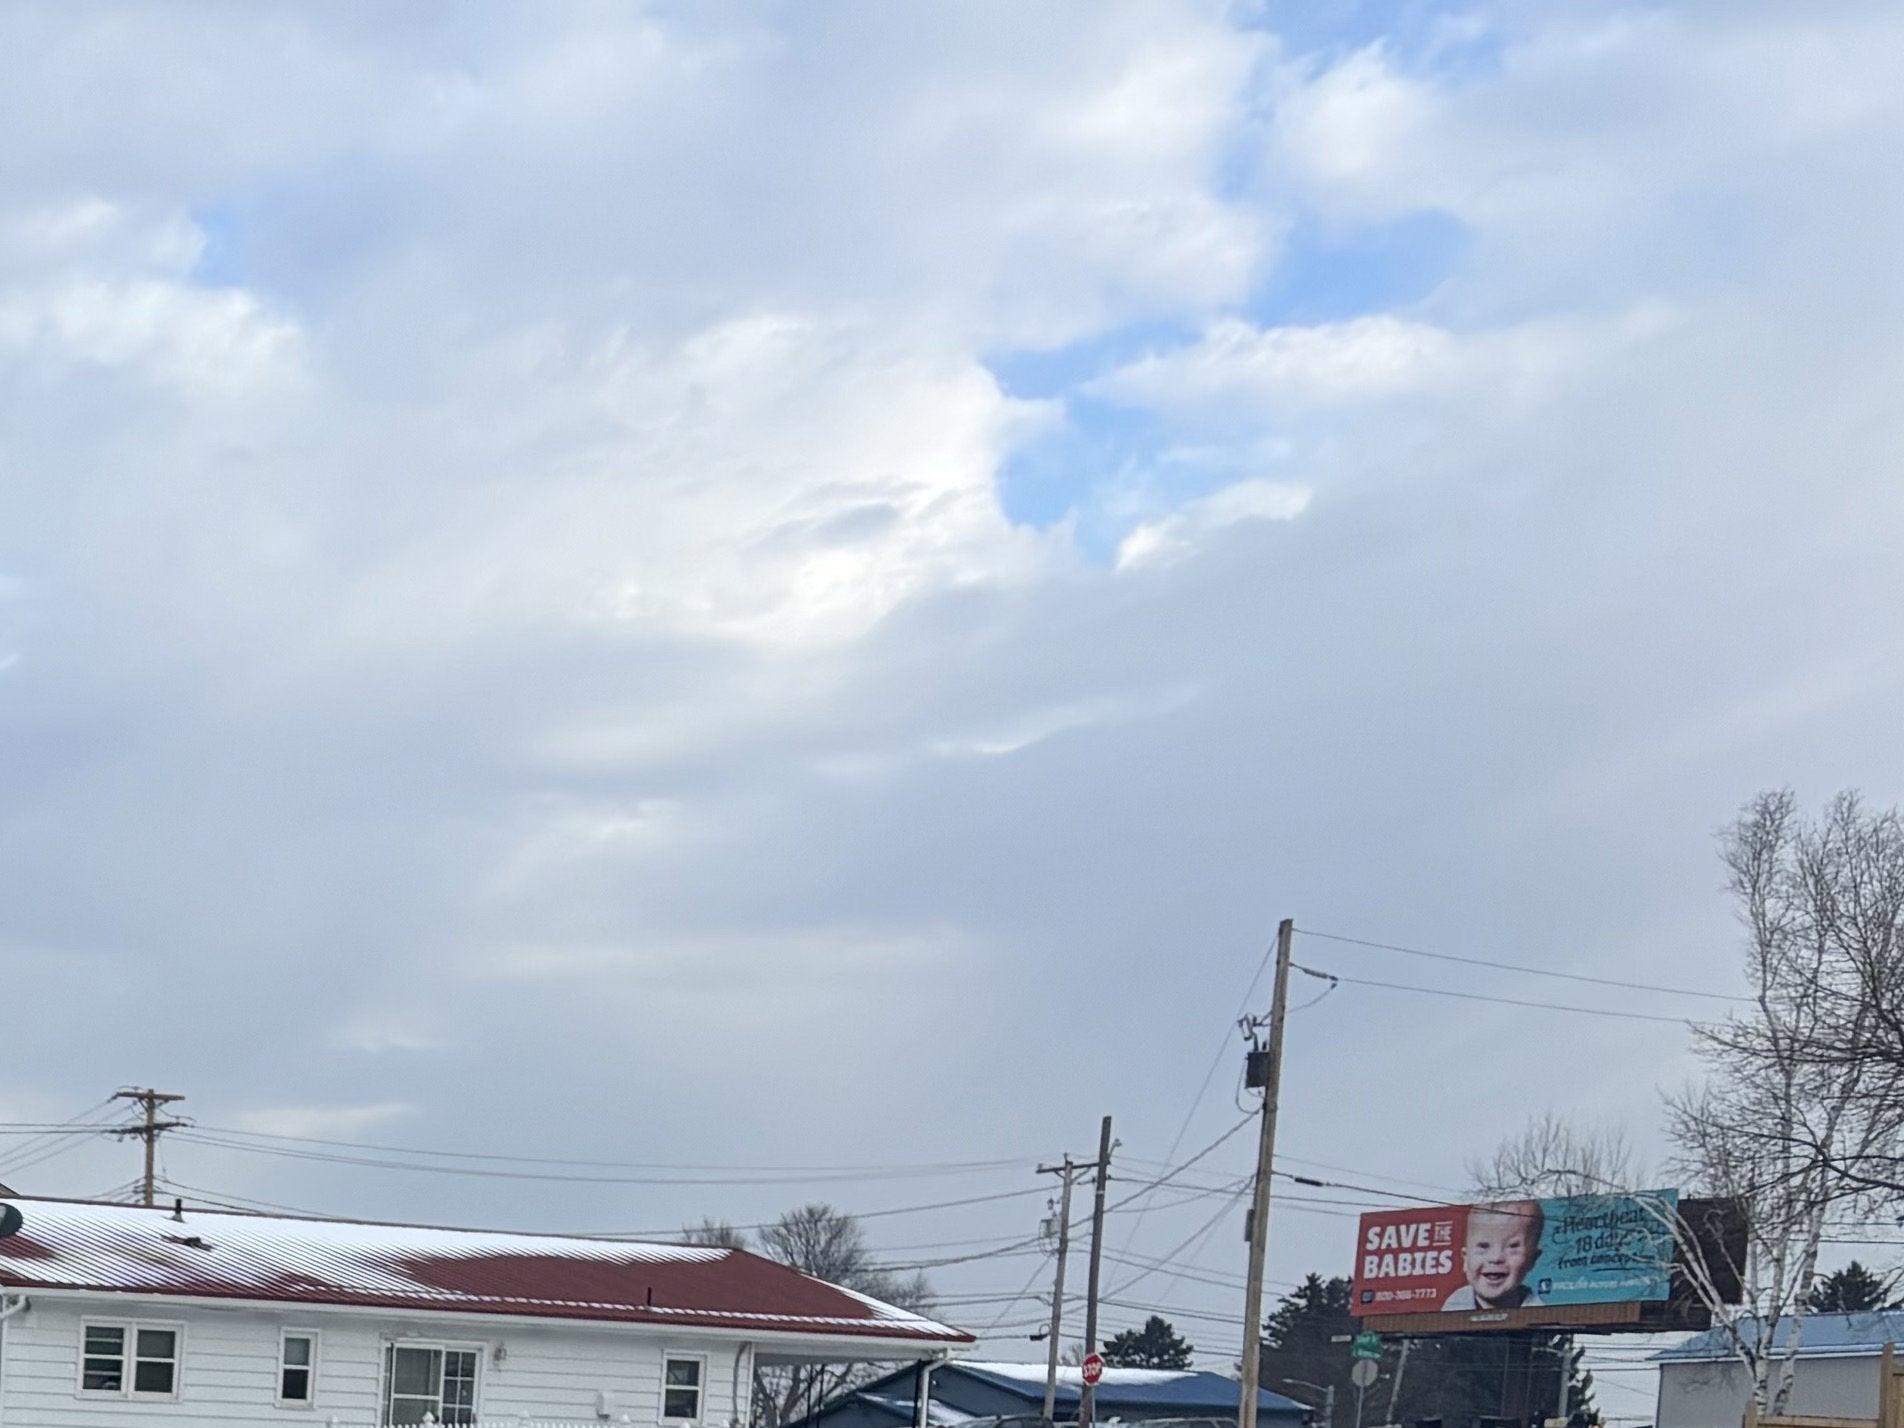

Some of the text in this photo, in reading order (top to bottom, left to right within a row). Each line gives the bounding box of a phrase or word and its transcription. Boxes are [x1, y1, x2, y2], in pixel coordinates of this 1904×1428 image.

[1365, 1222, 1431, 1251] SAVE
[1575, 1235, 1593, 1254] 18
[1363, 1249, 1453, 1279] BABIES
